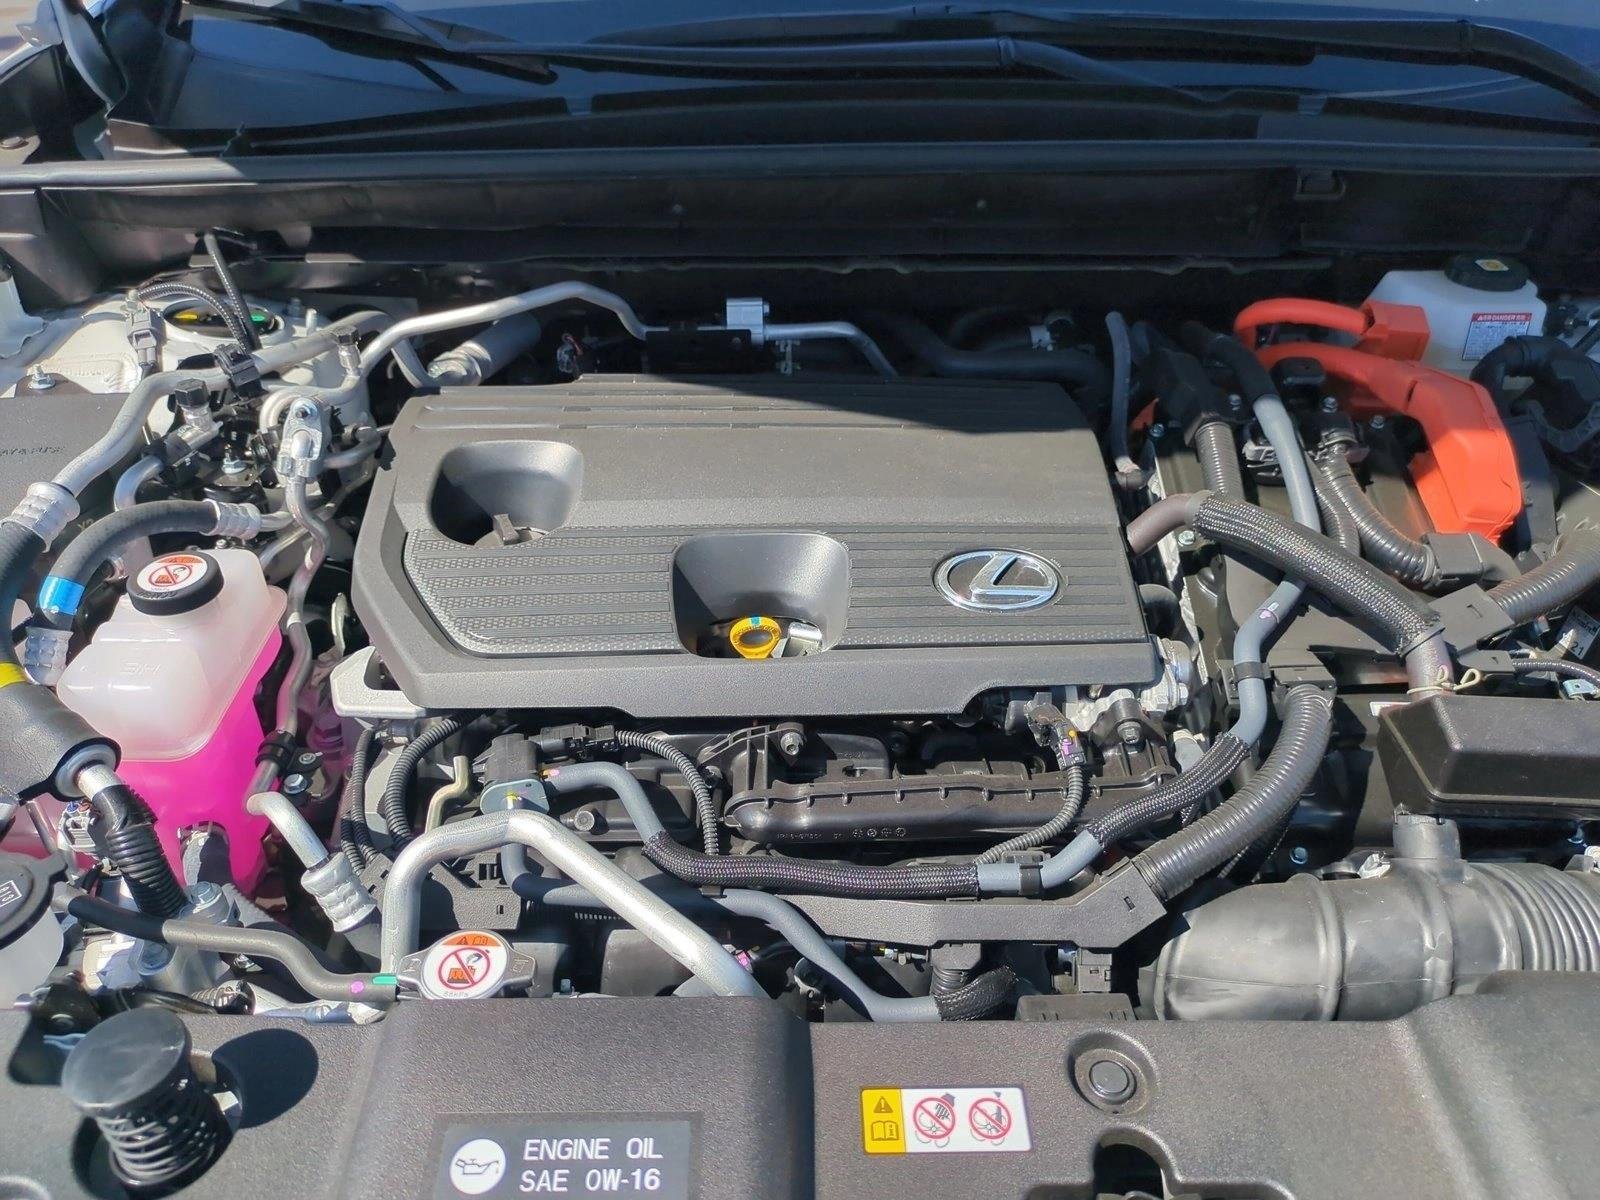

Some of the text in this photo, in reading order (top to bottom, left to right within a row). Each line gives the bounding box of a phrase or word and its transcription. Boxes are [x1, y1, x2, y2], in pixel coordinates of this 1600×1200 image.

[523, 1137, 664, 1161] ENGINE OIL
[519, 1168, 662, 1193] SAE 0W-16
